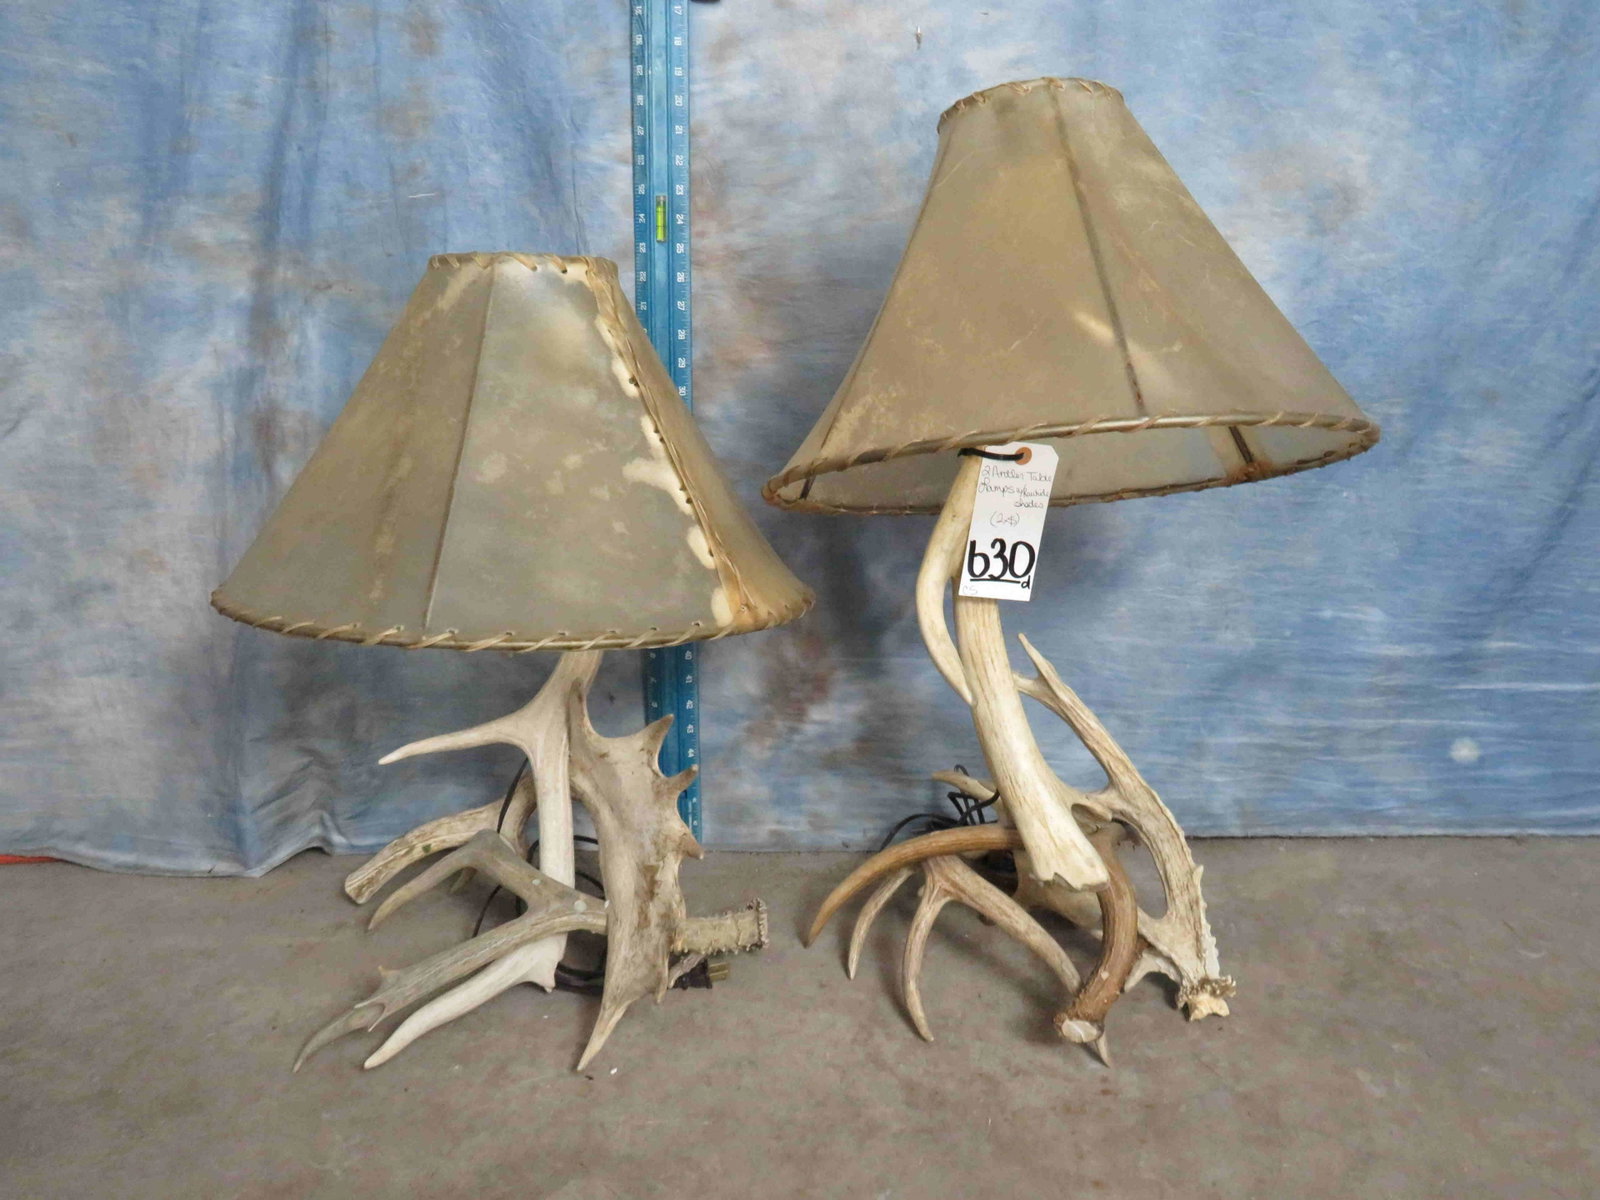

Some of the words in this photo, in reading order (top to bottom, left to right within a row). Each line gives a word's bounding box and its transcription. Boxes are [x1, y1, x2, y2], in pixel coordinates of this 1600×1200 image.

[674, 5, 682, 16] 17
[674, 36, 682, 46] 18
[675, 67, 682, 76] 19
[675, 95, 683, 107] 20
[637, 125, 644, 136] 27
[675, 125, 683, 135] 21
[675, 155, 683, 166] 22
[639, 184, 645, 195] 25
[676, 184, 684, 195] 23
[639, 213, 646, 224] 24
[676, 214, 684, 225] 24
[640, 242, 646, 253] 23
[676, 243, 684, 254] 25
[640, 271, 646, 282] 22
[677, 272, 685, 283] 26
[640, 301, 647, 311] 21
[677, 301, 685, 311] 27
[678, 329, 686, 340] 28
[678, 357, 686, 368] 29
[679, 386, 686, 396] 30
[981, 465, 990, 476] 2
[992, 465, 1024, 480] Antler
[685, 674, 693, 684] 41
[686, 699, 694, 710] 42
[687, 724, 694, 734] 43
